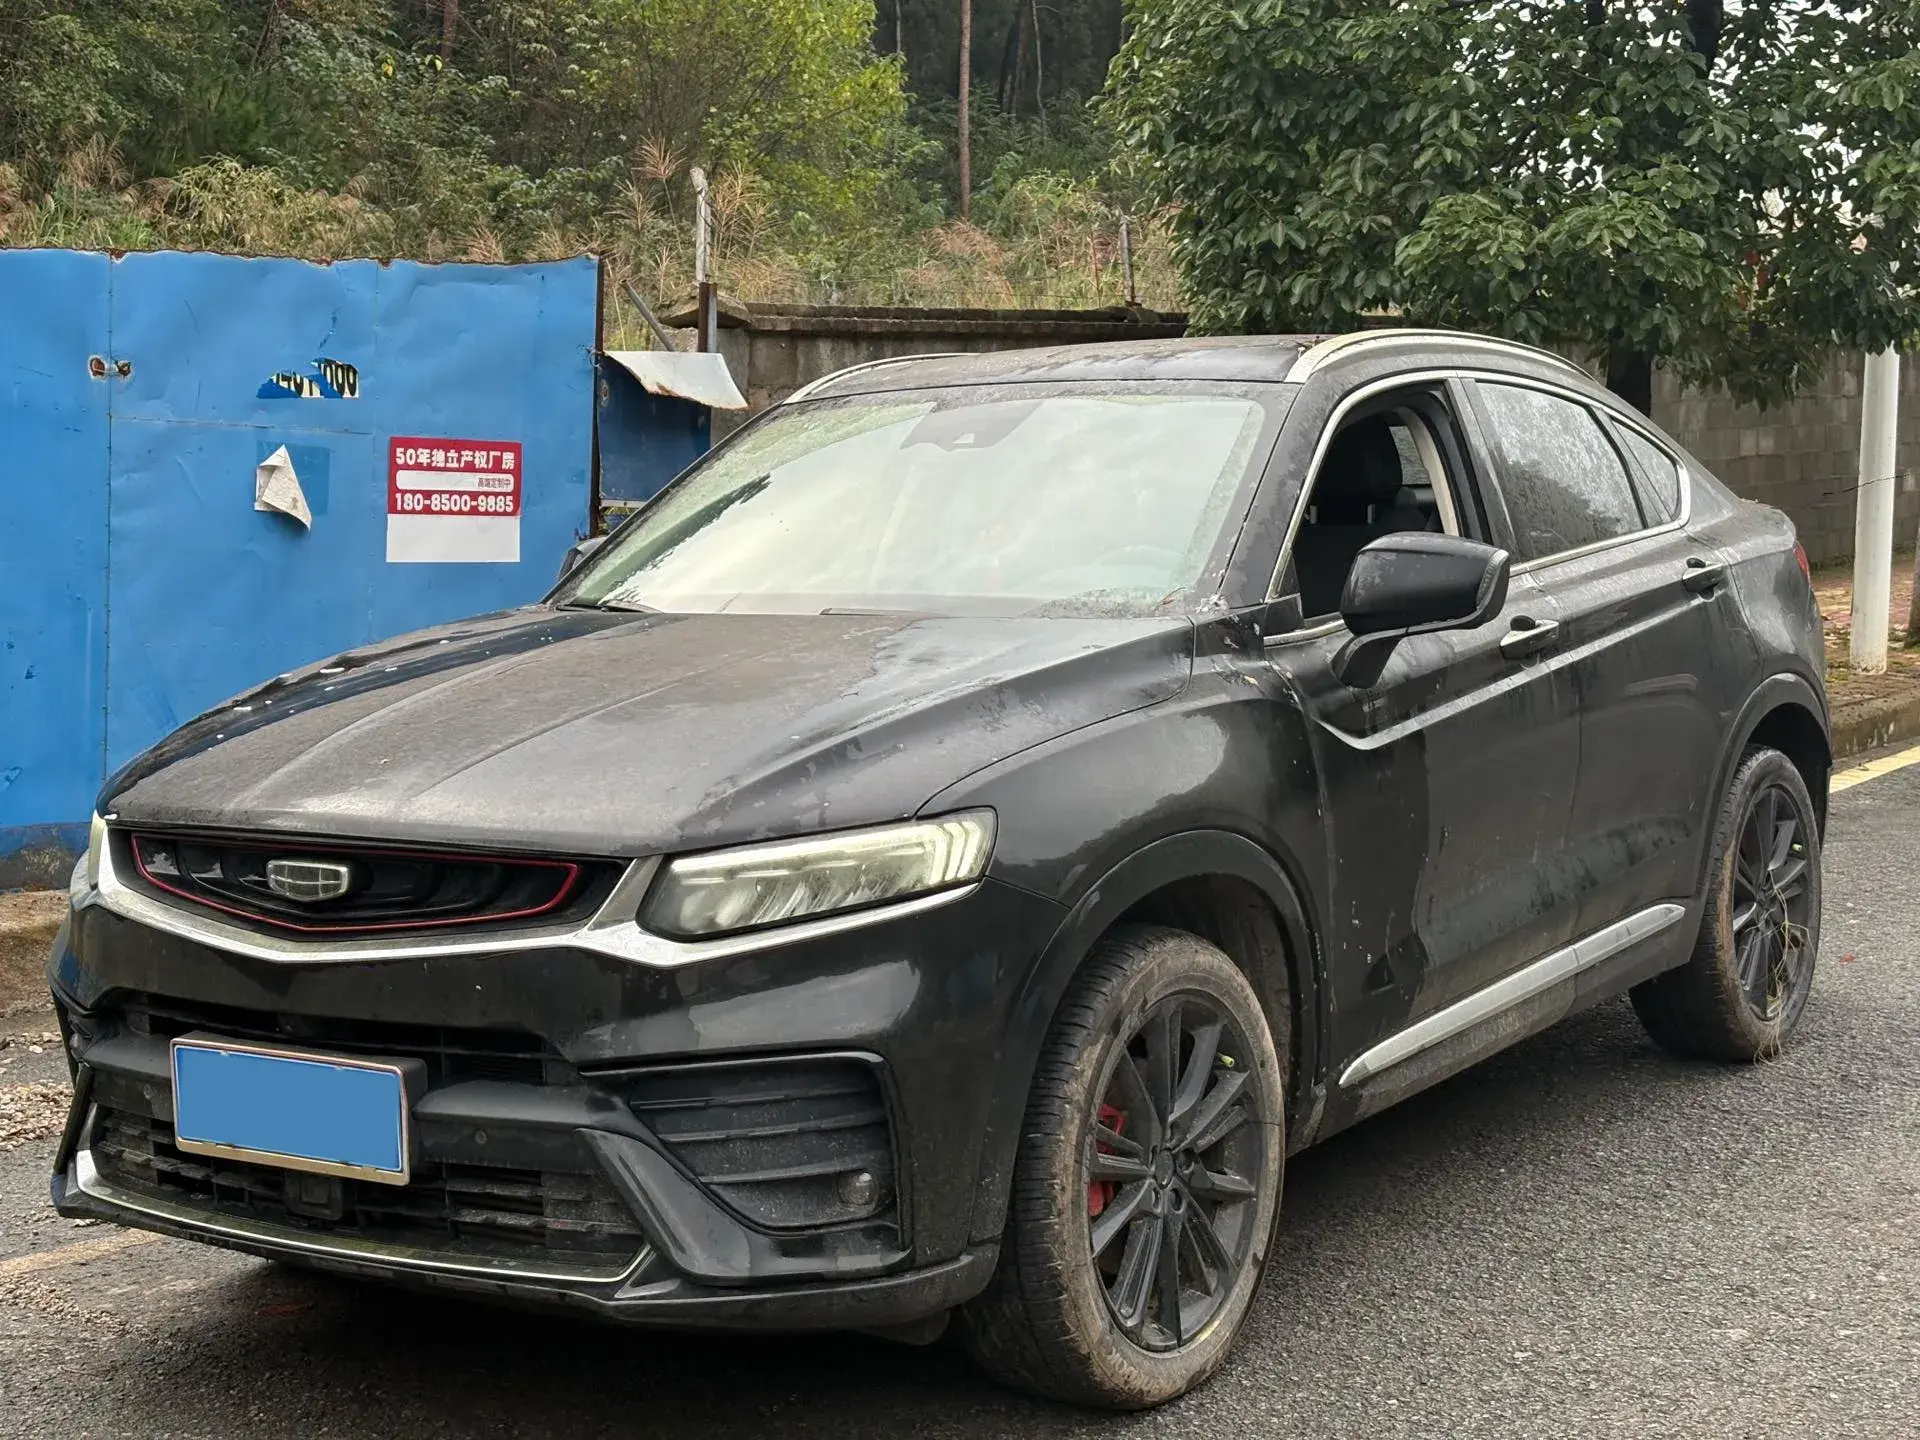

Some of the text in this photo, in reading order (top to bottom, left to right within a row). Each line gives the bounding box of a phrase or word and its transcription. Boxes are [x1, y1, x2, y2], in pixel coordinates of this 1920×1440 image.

[395, 447, 515, 469] 50年独立产权厂房
[395, 493, 513, 513] 180-8500-9885
